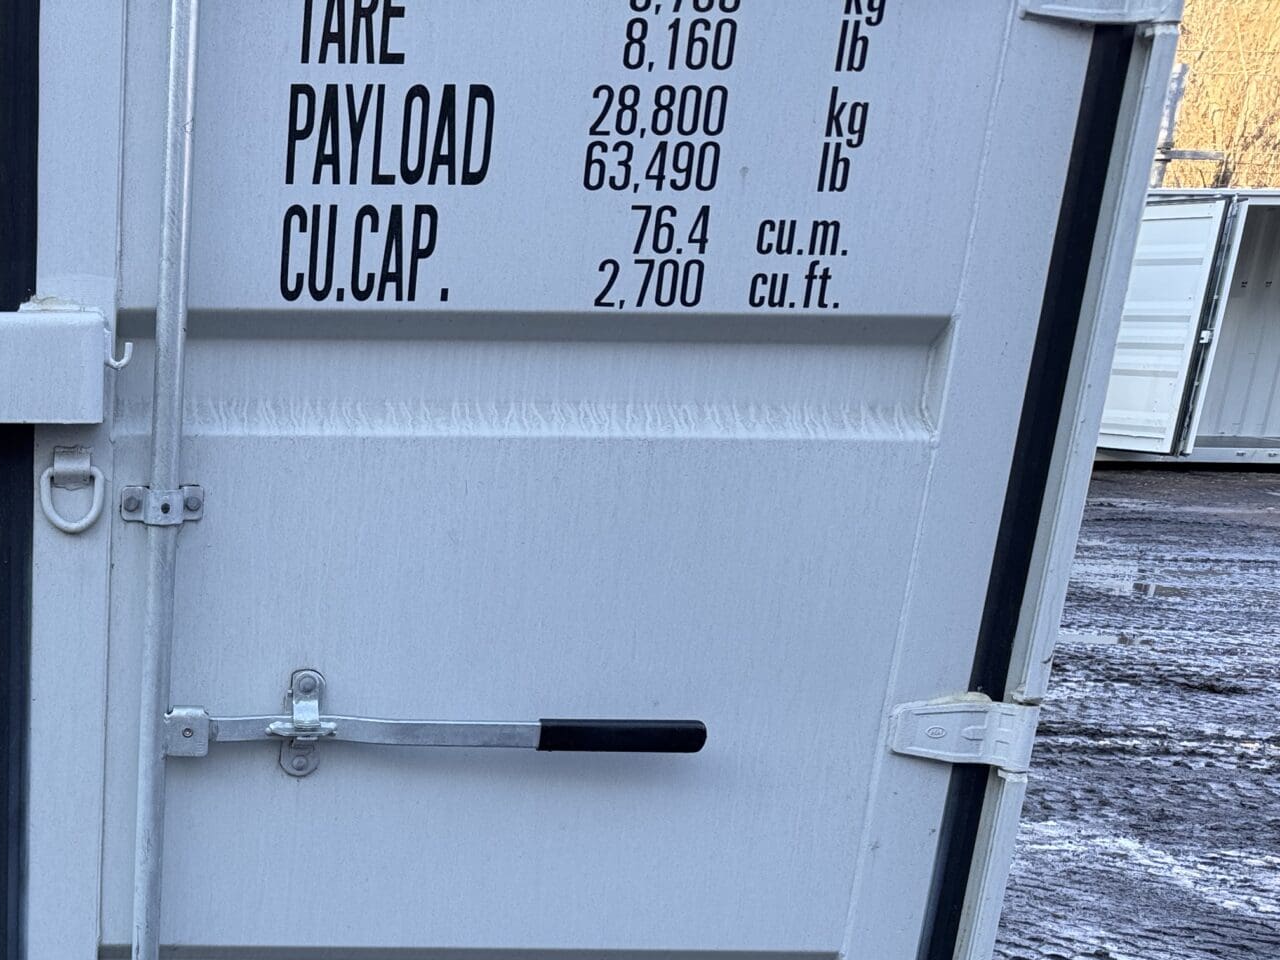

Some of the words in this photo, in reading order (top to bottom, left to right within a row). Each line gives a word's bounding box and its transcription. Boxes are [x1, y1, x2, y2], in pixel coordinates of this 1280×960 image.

[623, 18, 737, 72] 8,160
[835, 20, 869, 71] lb
[286, 84, 494, 185] PAYLOAD
[589, 85, 728, 138] 28,800
[824, 87, 869, 148] kg
[584, 141, 720, 193] 63,490
[818, 143, 850, 192] lb
[632, 205, 710, 254] 76.4
[757, 220, 847, 256] cu.m.
[594, 259, 704, 308] 2,700
[749, 260, 839, 308] cu.ft.
